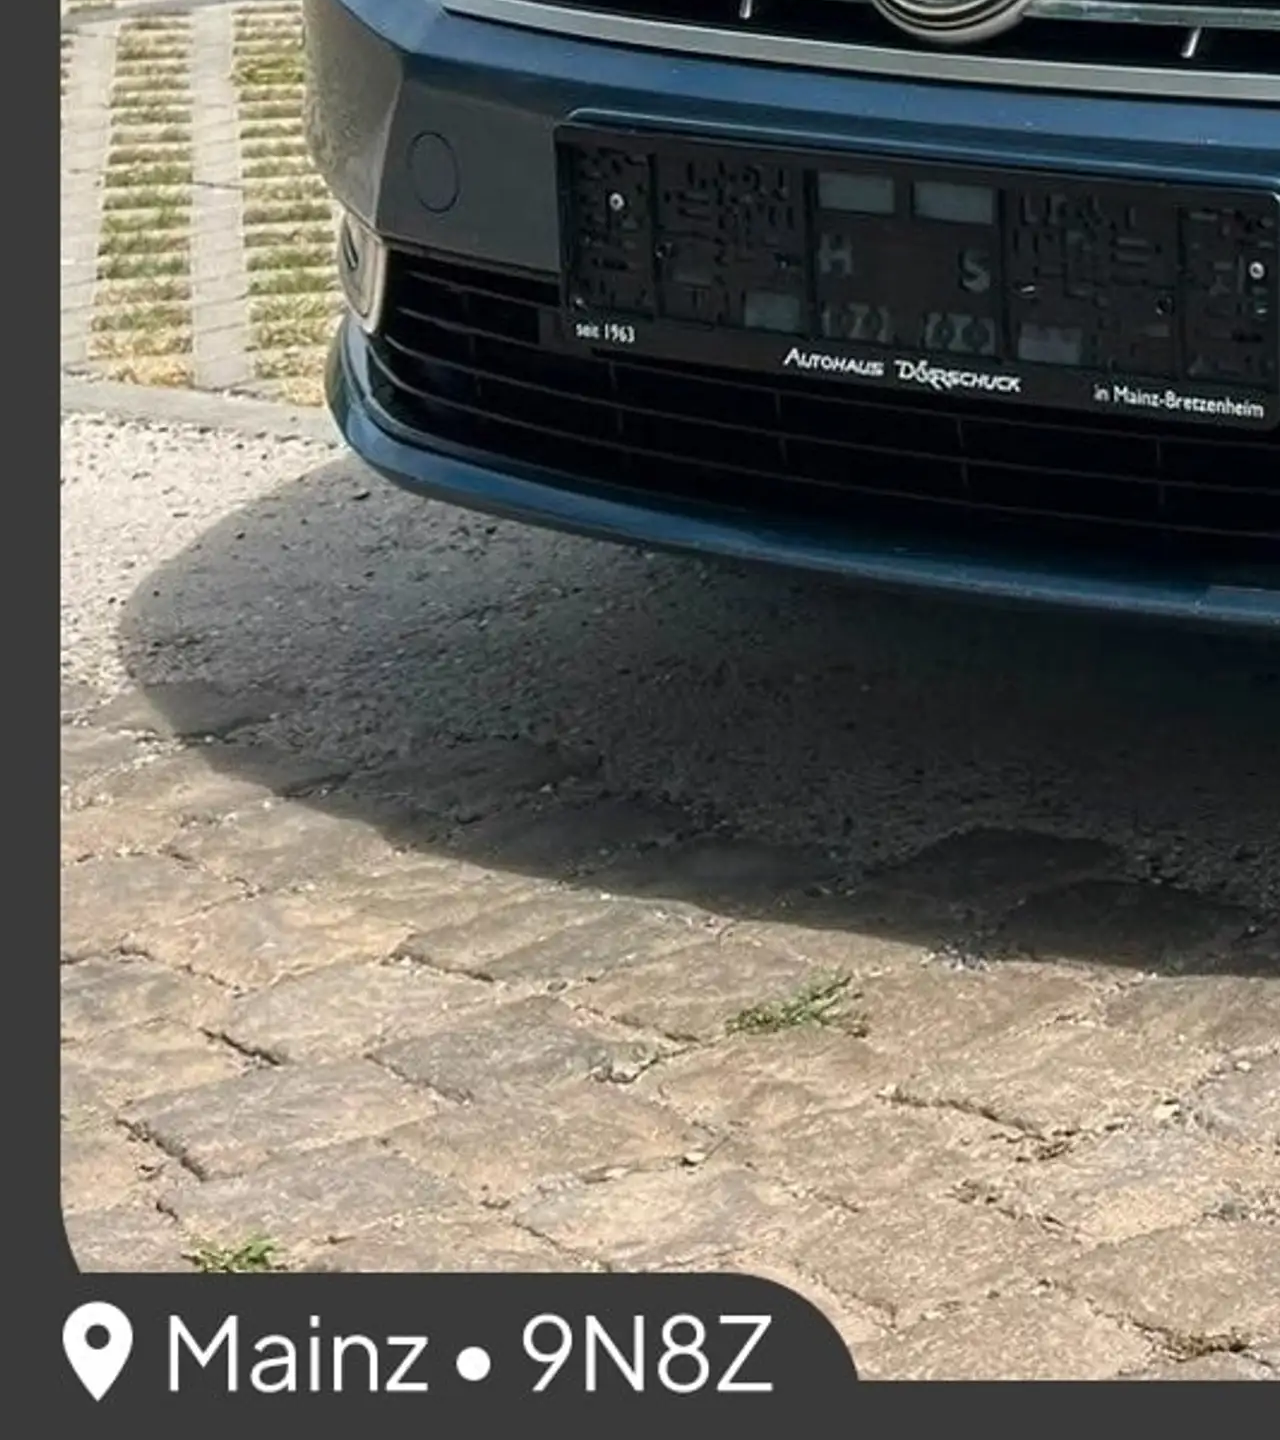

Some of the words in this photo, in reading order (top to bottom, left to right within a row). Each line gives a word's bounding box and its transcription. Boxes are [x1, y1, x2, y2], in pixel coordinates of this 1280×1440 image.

[604, 323, 636, 344] 1963
[783, 347, 885, 378] AUTOHAUS
[1094, 384, 1110, 402] in
[1113, 385, 1265, 419] Mainz-Bretzenheim
